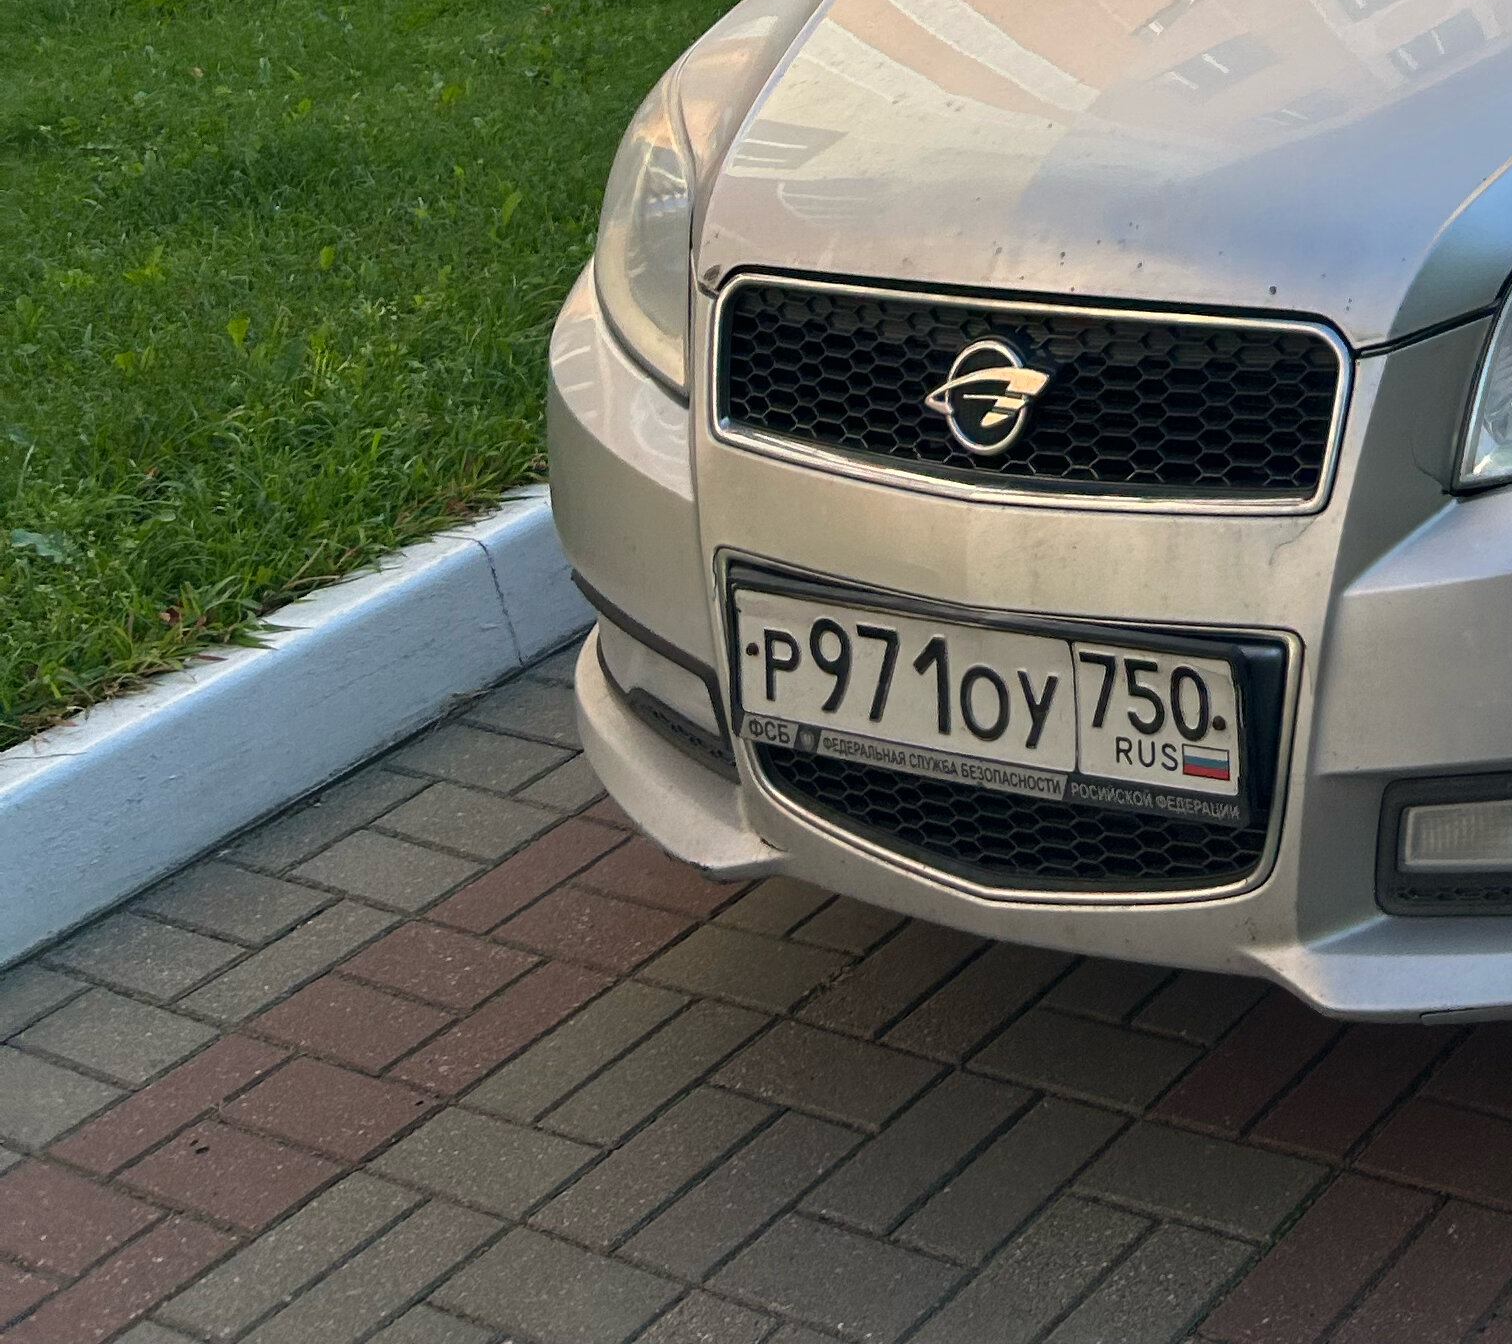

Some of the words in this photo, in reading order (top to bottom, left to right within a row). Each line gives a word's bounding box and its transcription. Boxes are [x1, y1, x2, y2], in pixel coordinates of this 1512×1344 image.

[1078, 650, 1210, 742] 750
[749, 718, 792, 745] ФСБ
[822, 736, 907, 766] ФЕДЕРАЛЬНАЯ
[909, 752, 958, 776] СЛУЖБА
[960, 763, 1062, 794] БЕЗОПАСНОСТИ
[1155, 795, 1240, 819] ФЕДЕРАЦИИ
[1115, 736, 1179, 772] RUS
